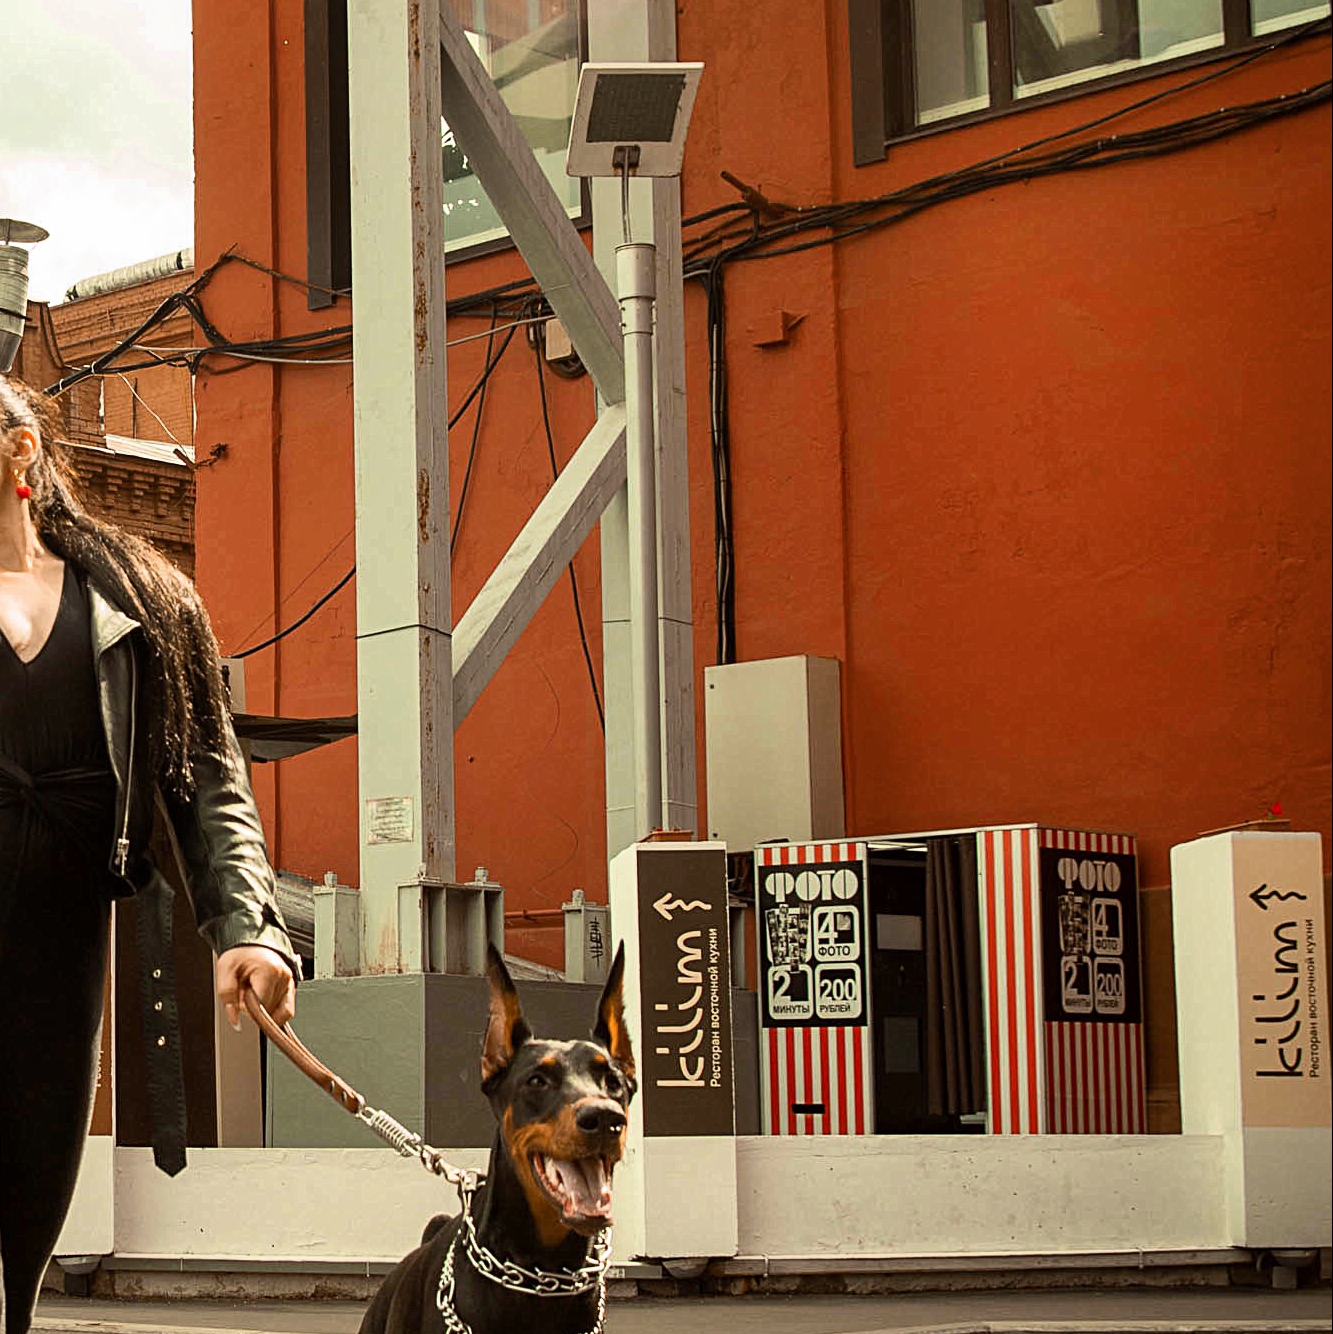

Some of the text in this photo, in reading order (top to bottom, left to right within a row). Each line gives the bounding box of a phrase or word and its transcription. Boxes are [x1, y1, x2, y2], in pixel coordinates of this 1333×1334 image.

[766, 869, 858, 903] ФОТО
[1058, 858, 1121, 892] ФОТО
[818, 911, 838, 944] 4
[1095, 904, 1109, 938] 4
[818, 945, 851, 956] ФОТО
[773, 970, 791, 1001] 2
[820, 978, 856, 1000] 200
[1066, 961, 1078, 995] 2
[1097, 974, 1122, 996] 200
[707, 928, 722, 1087] Ресторан восточной кухни
[773, 1005, 810, 1014] МИНУТЫ
[819, 1003, 850, 1012] РУБЛЕЙ
[1306, 919, 1320, 1078] Ресторан восточной кухни
